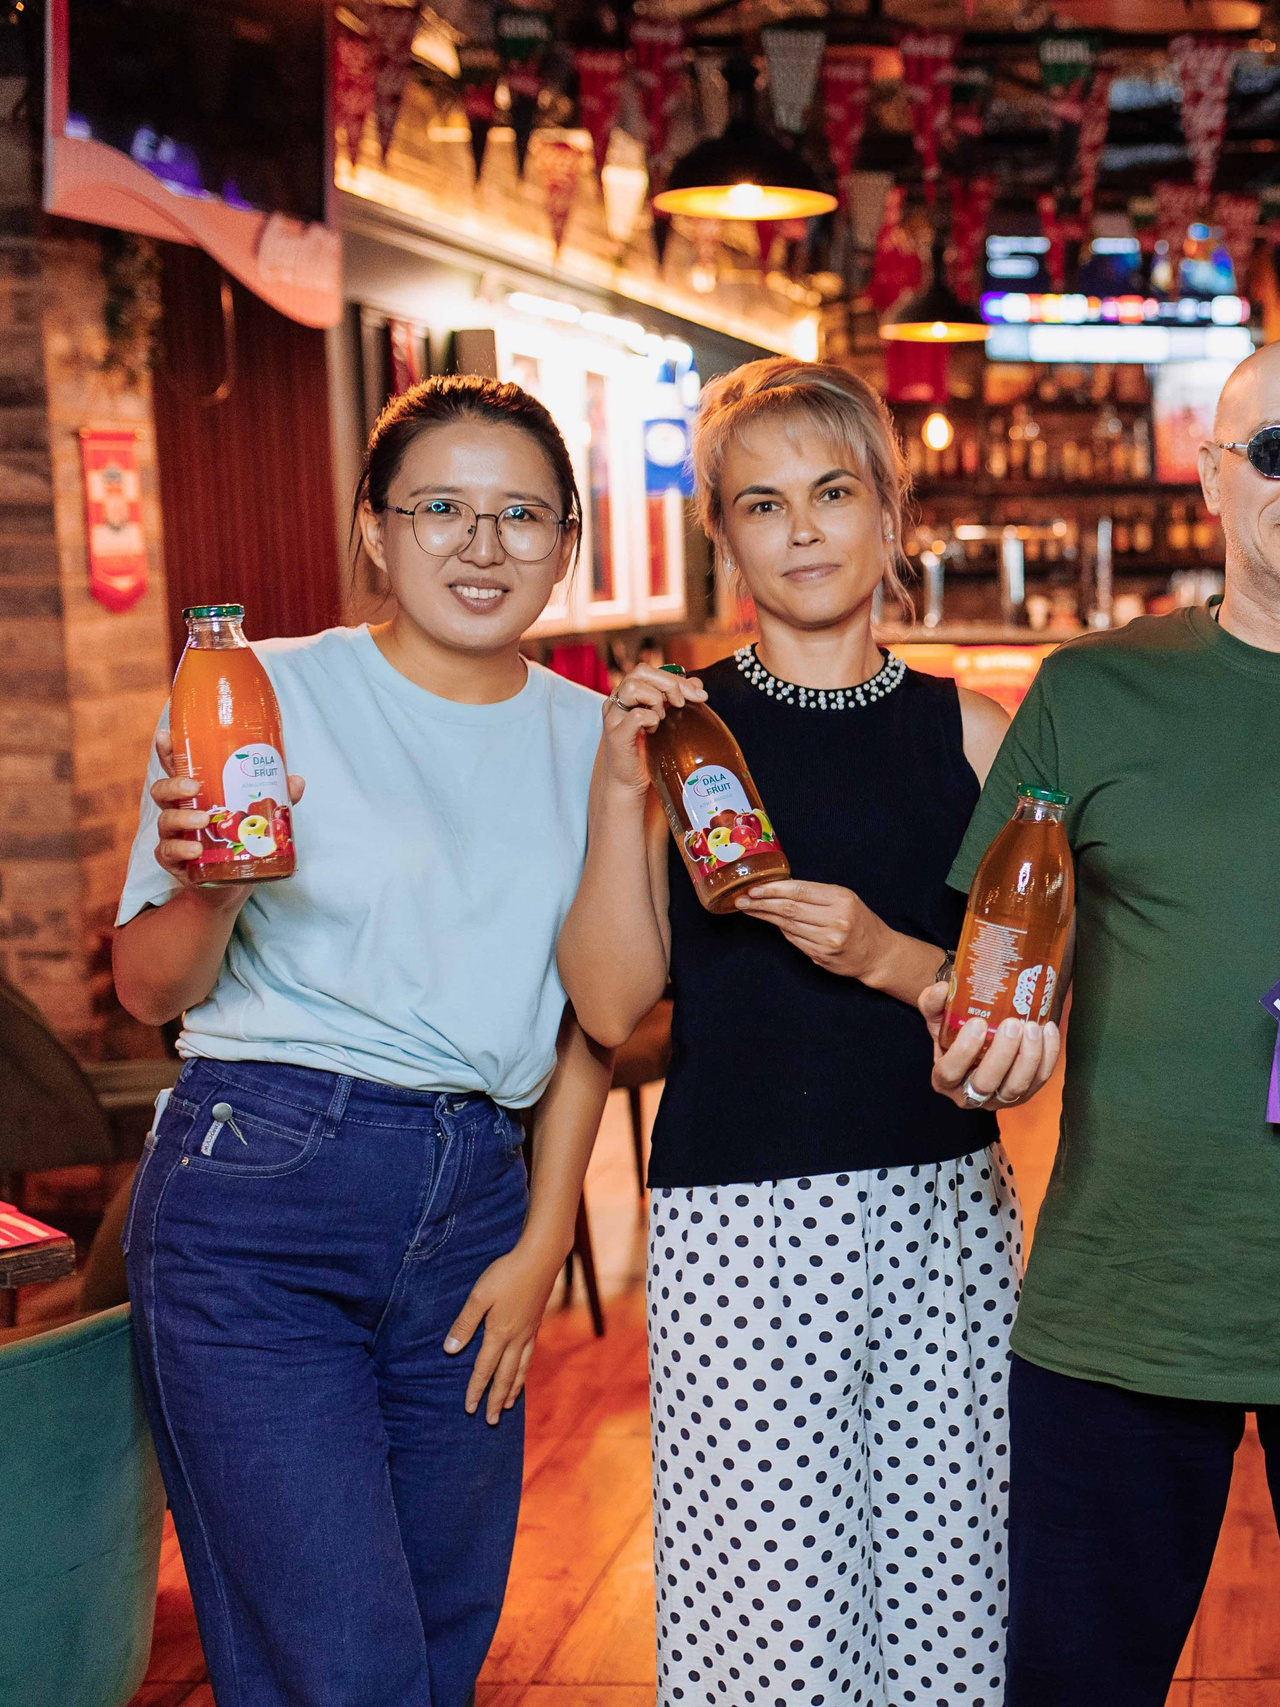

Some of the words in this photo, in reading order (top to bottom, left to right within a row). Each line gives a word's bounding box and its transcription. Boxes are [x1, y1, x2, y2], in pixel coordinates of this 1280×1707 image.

[253, 756, 275, 766] DALA
[254, 768, 278, 778] FRUIT
[702, 773, 726, 786] DALA
[706, 782, 731, 796] FRUIT
